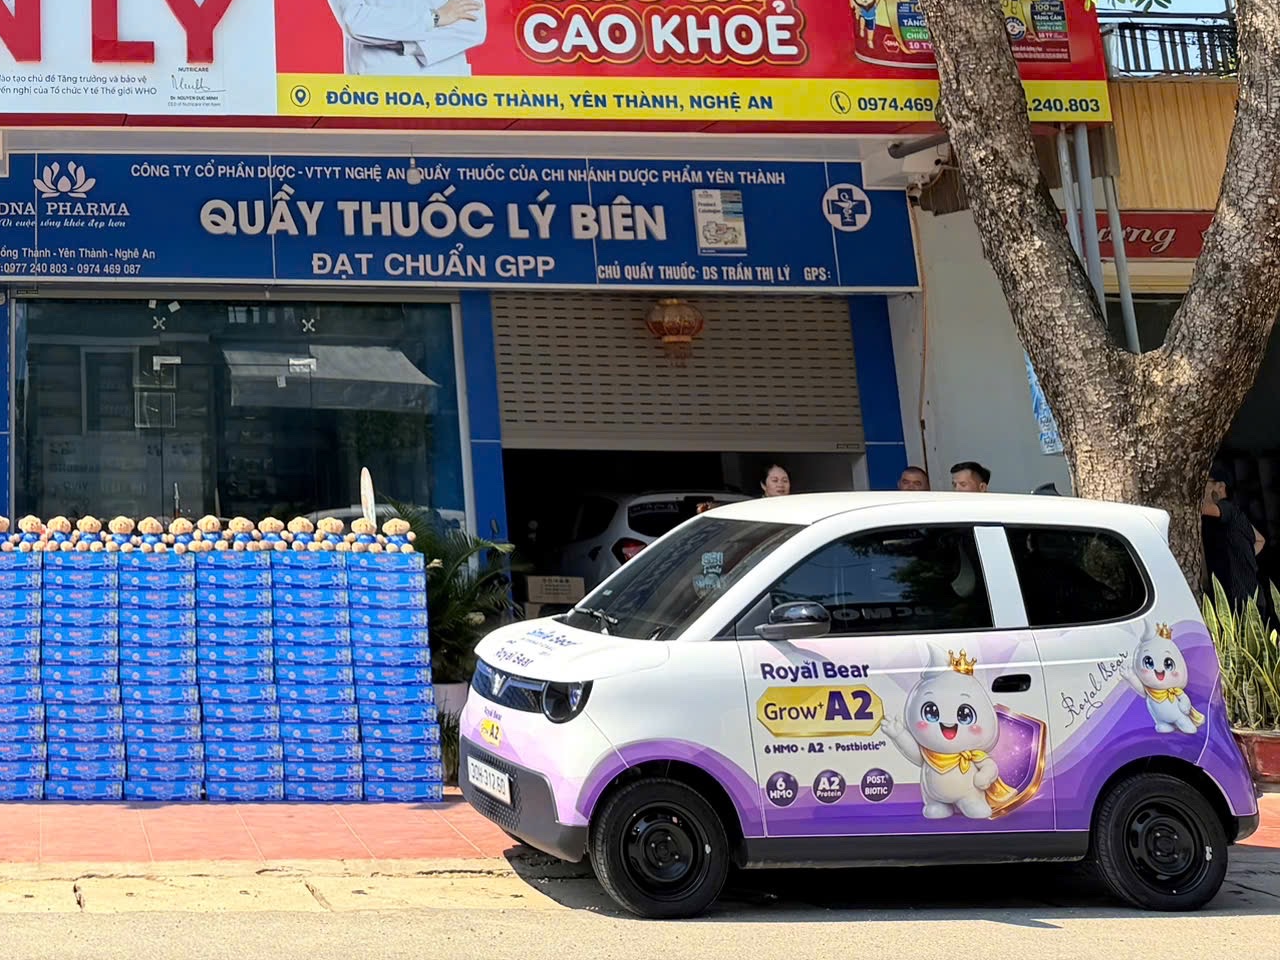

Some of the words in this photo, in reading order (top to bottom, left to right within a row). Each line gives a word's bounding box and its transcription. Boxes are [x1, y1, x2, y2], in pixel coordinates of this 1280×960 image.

[523, 13, 637, 54] CAO
[655, 1, 798, 55] KHOẺ
[326, 86, 378, 105] ĐỒNG
[385, 93, 431, 111] HOA,
[435, 87, 488, 106] ĐỒNG
[494, 88, 564, 110] THÀNH,
[570, 88, 610, 109] YÊN
[616, 88, 683, 111] THÀNH,
[689, 90, 741, 111] NGHỆ
[747, 96, 773, 110] AN
[131, 162, 169, 177] CÔNG
[174, 165, 190, 177] TY
[194, 160, 215, 177] CỔ
[218, 161, 254, 178] PHẦN
[257, 166, 295, 182] DƯỢC
[305, 166, 341, 178] VTYT
[345, 164, 382, 181] NGHỆ
[386, 168, 405, 180] AN
[457, 163, 505, 181] THUỐC
[509, 163, 538, 181] CỦA
[541, 168, 565, 181] CHI
[569, 165, 616, 182] NHÁNH
[619, 168, 658, 186] DƯỢC
[662, 164, 702, 184] PHẨM
[706, 165, 734, 184] YÊN
[739, 167, 785, 185] THÀNH
[46, 202, 130, 216] PHARMA
[200, 183, 324, 237] QUẦY
[337, 185, 494, 239] THUỐC
[507, 190, 555, 240] LÝ
[571, 194, 667, 241] BIÊN
[29, 263, 47, 273] 240
[50, 263, 67, 273] 803
[78, 264, 100, 274] 0974
[103, 264, 120, 274] 469
[123, 265, 140, 274] 087
[312, 252, 374, 280] ĐẠT
[384, 243, 487, 277] CHUẨN
[494, 256, 555, 277] GPP
[597, 261, 620, 279] CHỦ
[703, 265, 718, 280] DS
[756, 266, 774, 283] THỊ
[778, 264, 790, 280] LÝ
[761, 661, 819, 682] Royal
[823, 660, 870, 678] Bear
[825, 690, 874, 721] A2
[764, 745, 772, 753] 6
[773, 744, 798, 753] HMO
[808, 743, 824, 753] A2
[770, 789, 793, 799] HMO
[818, 777, 840, 790] A2
[865, 787, 888, 795] BIOTIC
